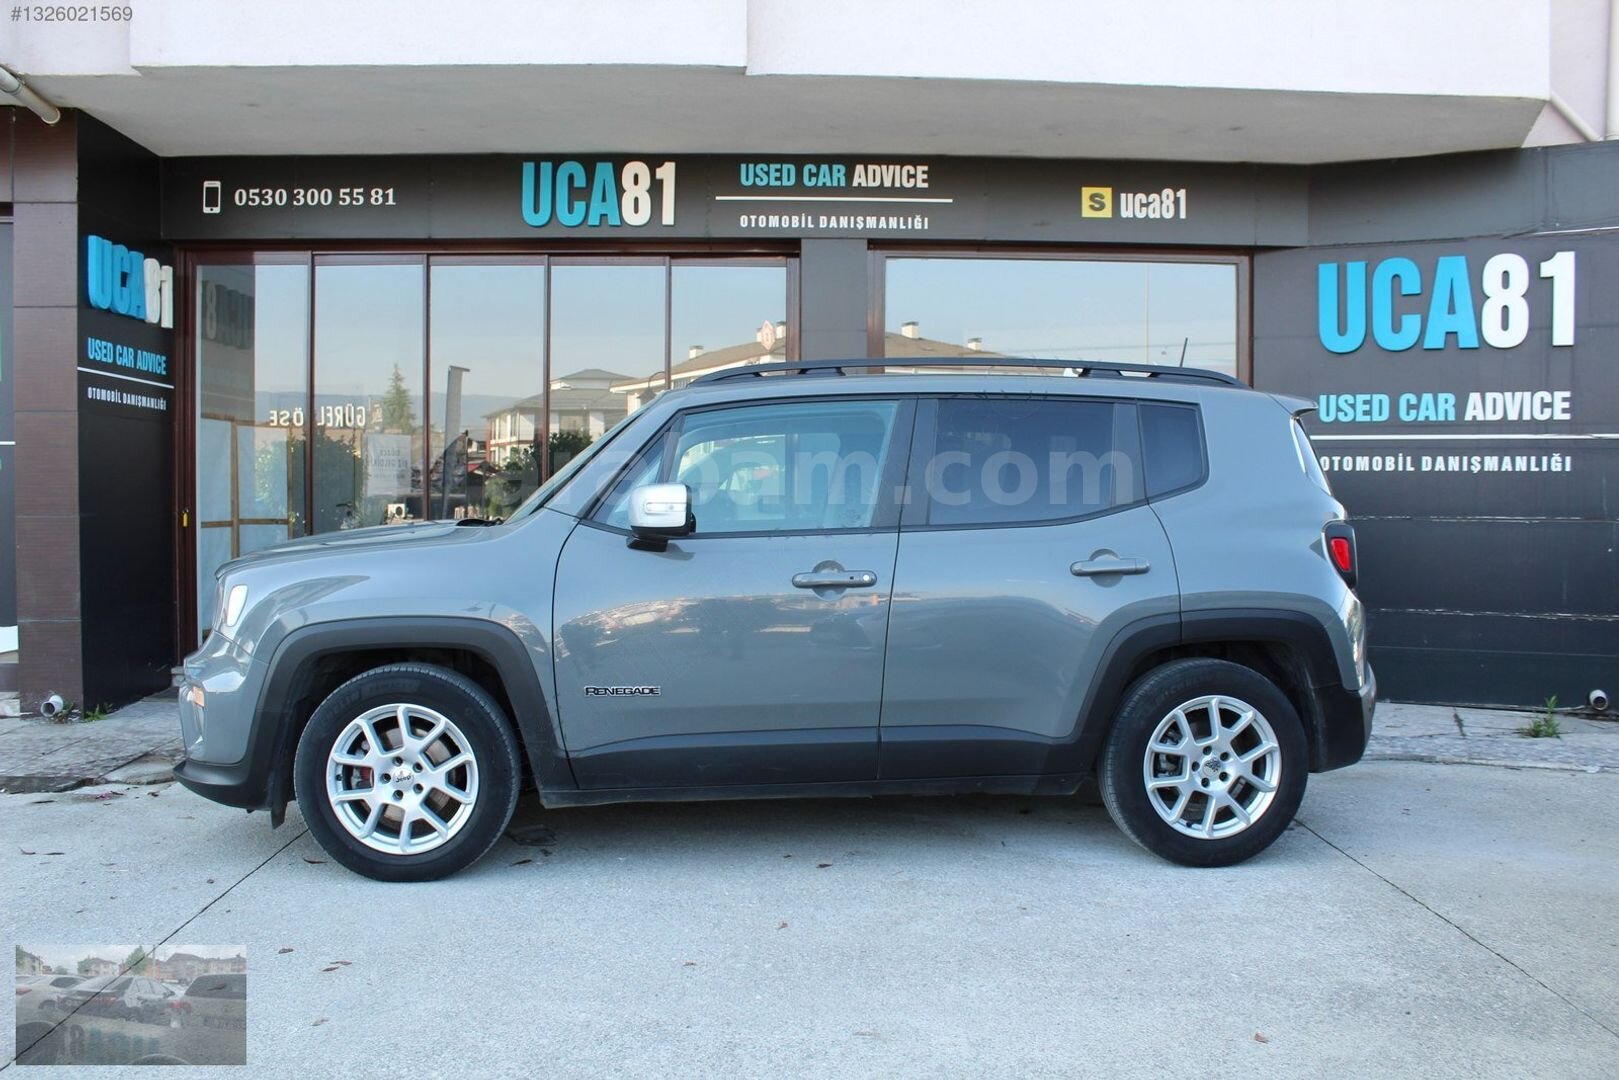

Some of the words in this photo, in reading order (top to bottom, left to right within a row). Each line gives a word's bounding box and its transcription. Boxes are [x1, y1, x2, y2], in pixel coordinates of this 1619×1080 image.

[740, 163, 796, 187] USED
[802, 163, 846, 187] CAR
[852, 164, 929, 189] ADVICE
[234, 188, 287, 206] 0530
[292, 188, 333, 206] 300
[338, 188, 365, 206] 55
[370, 187, 397, 206] 81
[521, 160, 676, 227] UCA81
[1120, 188, 1187, 219] uca81
[740, 213, 815, 228] OTOMOBİL
[819, 214, 929, 230] DANIŞMANLIĞI
[88, 235, 173, 329] UCA81
[1317, 250, 1576, 354] UCA81
[87, 336, 114, 363] USED
[116, 344, 135, 368] CAR
[136, 350, 167, 375] ADVICE
[87, 386, 121, 403] OTOMOBİL
[122, 392, 167, 411] DANIŞMANLIĞI
[1319, 393, 1390, 423] USED
[1399, 392, 1456, 422] CAR
[1464, 391, 1572, 422] ADVICE
[1320, 453, 1415, 472] OTOMOBİL
[1420, 453, 1572, 474] DANIŞMANLIĞI
[584, 686, 660, 697] RENEGADE
